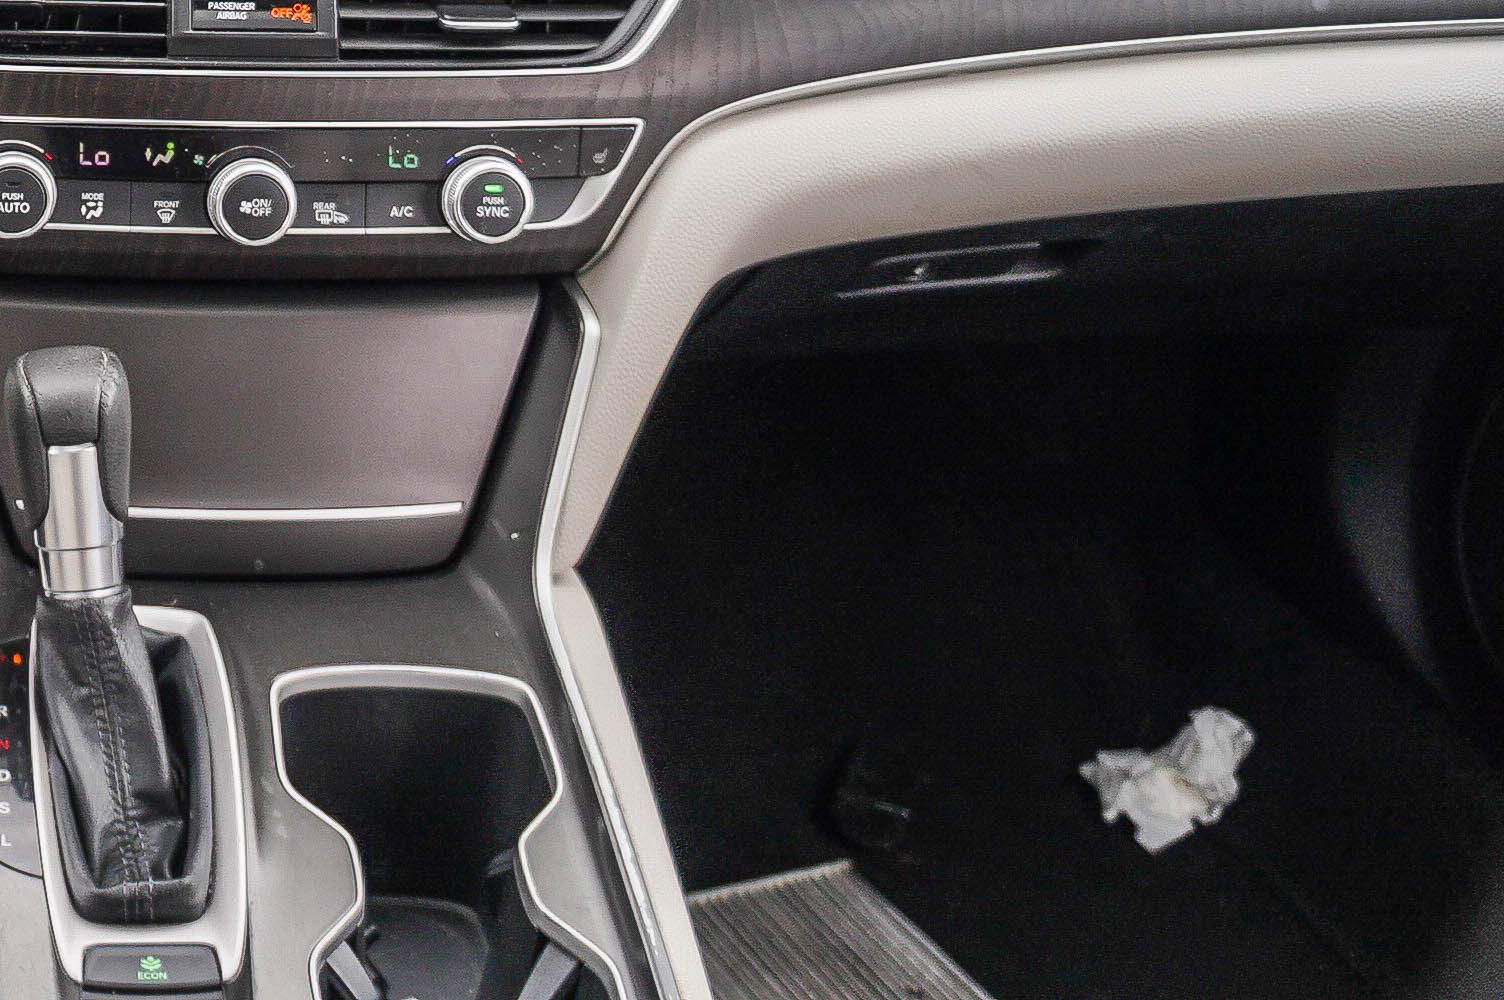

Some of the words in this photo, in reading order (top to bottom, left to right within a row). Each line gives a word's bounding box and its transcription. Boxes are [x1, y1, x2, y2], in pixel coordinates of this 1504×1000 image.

[207, 2, 256, 11] PASSENGER
[216, 12, 247, 21] AIRBAG
[270, 7, 294, 19] OFF
[1, 192, 24, 201] PUSH
[81, 192, 105, 201] MODE
[482, 196, 505, 205] PUSH
[153, 200, 180, 209] FRONT
[252, 198, 273, 208] ON/
[313, 202, 336, 211] REAR
[252, 207, 273, 217] OFF
[389, 206, 415, 218] A/C
[475, 206, 510, 218] SYNC
[0, 801, 11, 814] S
[0, 833, 12, 847] L
[137, 971, 168, 980] ECON
